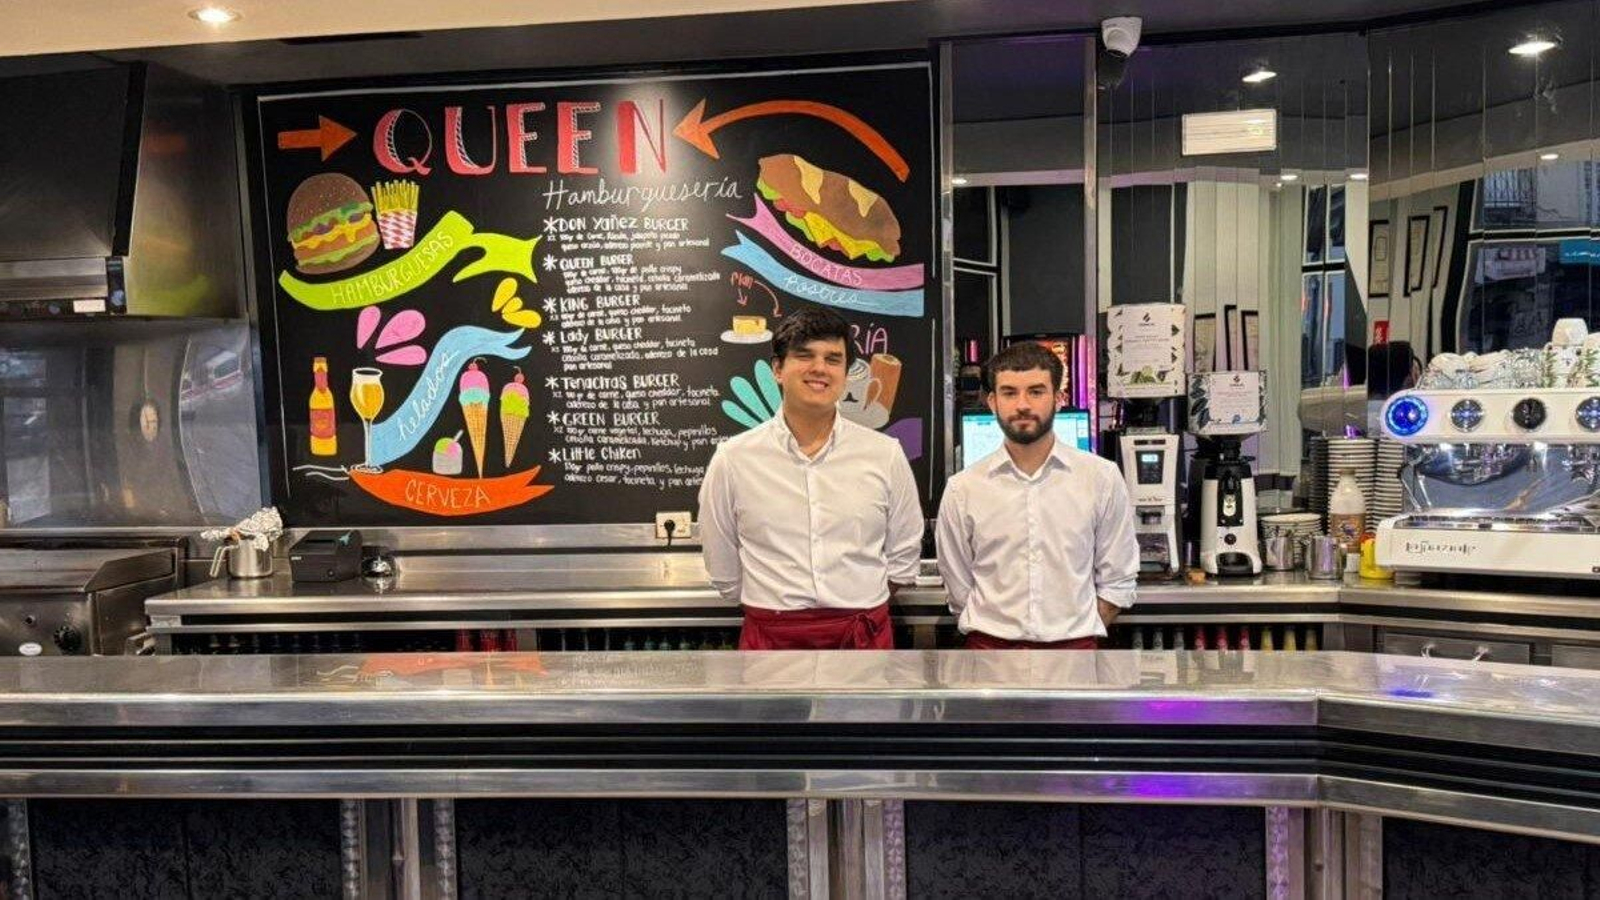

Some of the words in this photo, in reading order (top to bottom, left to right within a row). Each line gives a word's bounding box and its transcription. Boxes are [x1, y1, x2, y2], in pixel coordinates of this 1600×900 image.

[372, 98, 668, 175] QUEEN
[542, 176, 743, 212] Hamburguesería
[559, 217, 586, 232] DON
[643, 217, 689, 231] BURGER
[655, 243, 661, 251] y
[663, 242, 676, 251] pan
[330, 231, 454, 304] HAMBURGUESAS
[560, 257, 594, 270] QUEEN
[600, 253, 633, 266] BURGER
[789, 244, 862, 286] BOCATAS
[641, 264, 658, 275] pollo
[660, 265, 682, 275] crispy
[593, 283, 602, 291] de
[614, 283, 630, 291] casa
[632, 285, 638, 293] y
[640, 283, 652, 293] pan
[784, 274, 864, 304] Postres
[560, 296, 589, 312] KING
[596, 294, 640, 308] BURGER
[608, 308, 628, 318] queso
[587, 318, 595, 326] de
[624, 318, 630, 327] y
[632, 315, 645, 326] pan
[560, 328, 589, 345] Lady
[595, 327, 642, 342] BURGER
[580, 345, 588, 353] de
[612, 343, 632, 354] queso
[676, 348, 686, 358] de
[690, 347, 698, 357] la
[563, 363, 578, 373] pan
[579, 361, 613, 370] artesanal
[632, 372, 681, 388] BURGER
[399, 350, 458, 441] helados
[586, 391, 596, 399] de
[598, 400, 609, 410] de
[622, 401, 640, 410] casa
[643, 401, 649, 410] y
[652, 398, 667, 409] pan
[669, 397, 711, 407] artesanal
[562, 412, 606, 426] GREEN
[613, 411, 661, 426] BURGER
[587, 427, 607, 435] carne
[679, 424, 718, 439] pepinillos
[683, 441, 689, 452] y
[691, 438, 708, 450] pan
[562, 446, 596, 461] Little
[586, 463, 604, 473] pollo
[564, 473, 593, 482] aderezo
[660, 478, 665, 490] y
[668, 477, 683, 488] pan
[405, 479, 491, 509] CERVEZA
